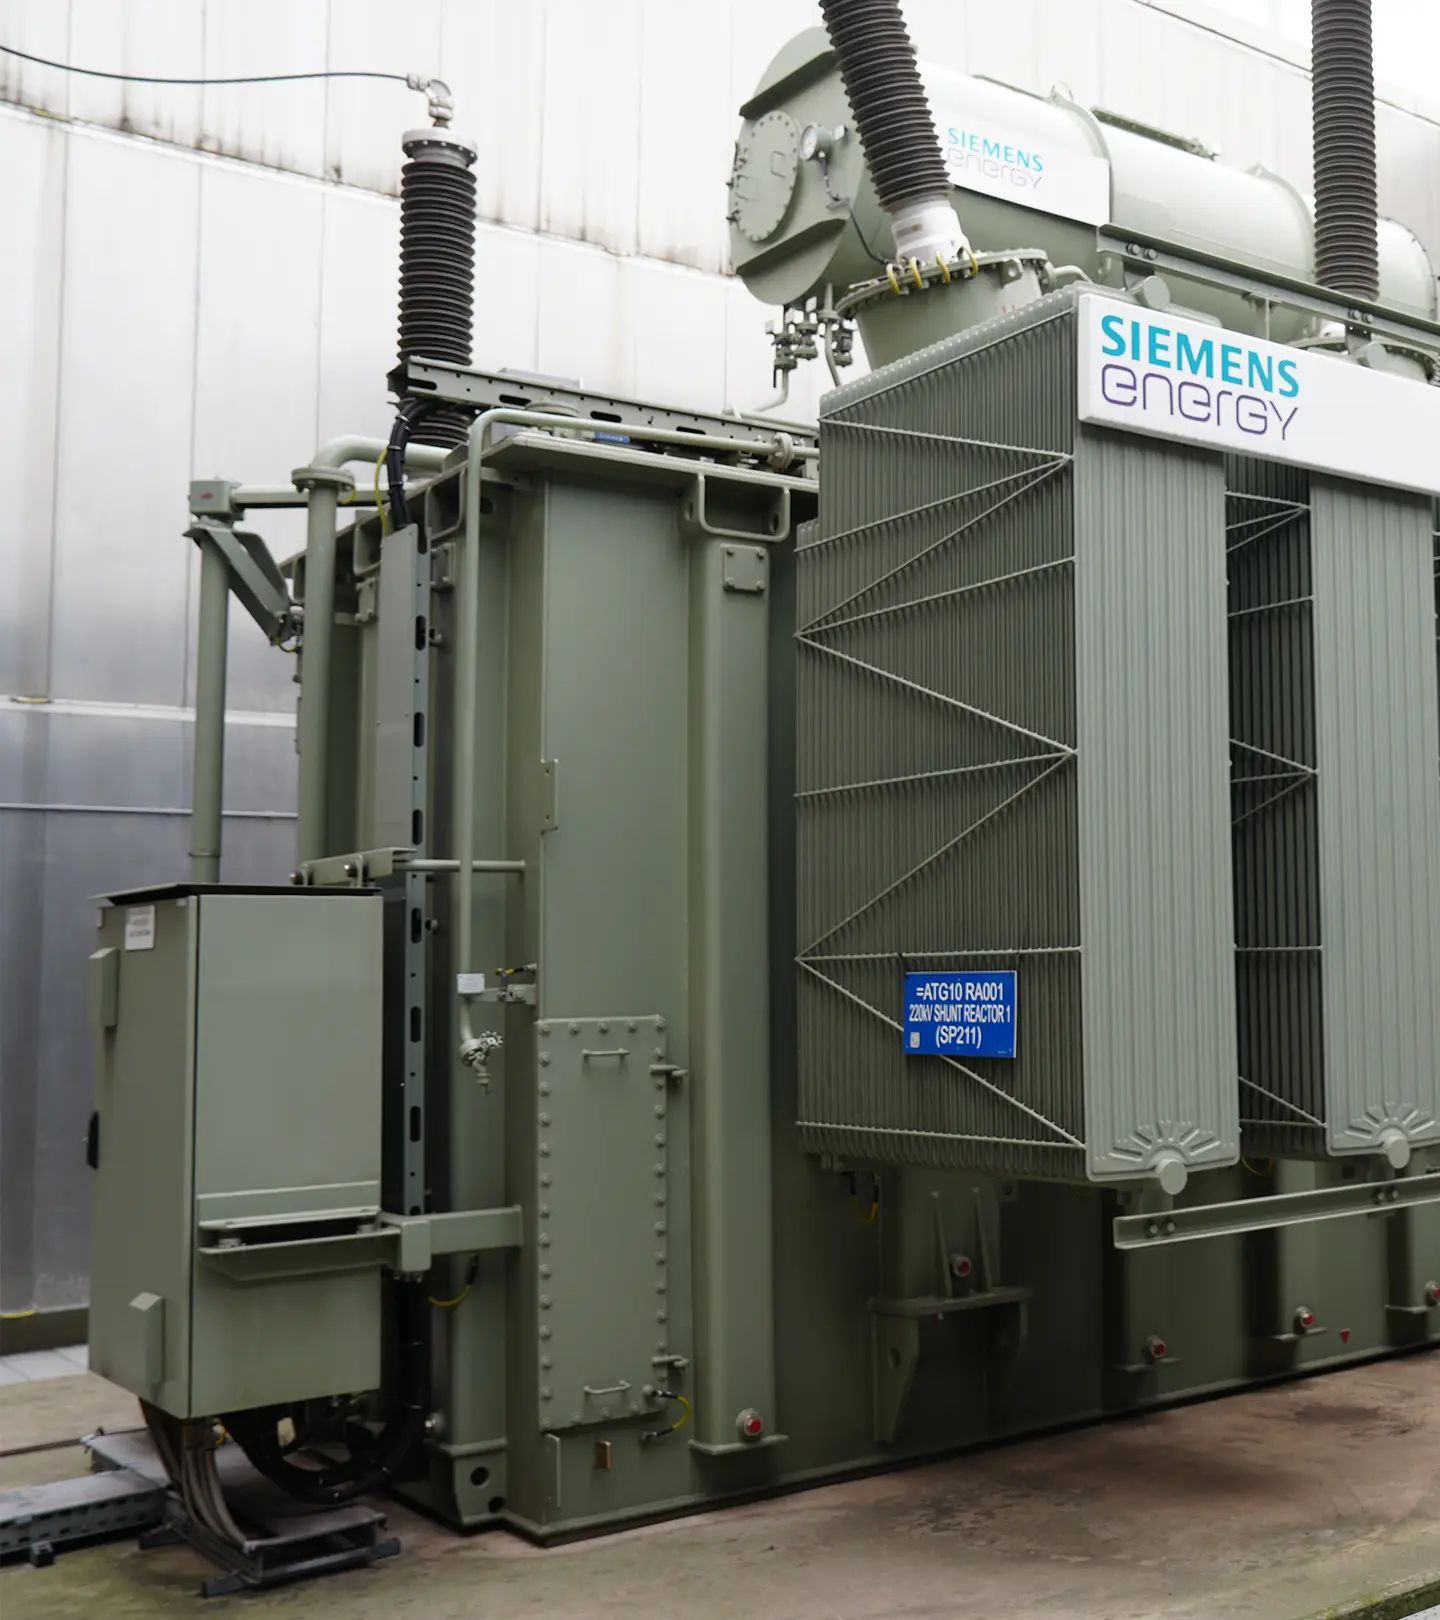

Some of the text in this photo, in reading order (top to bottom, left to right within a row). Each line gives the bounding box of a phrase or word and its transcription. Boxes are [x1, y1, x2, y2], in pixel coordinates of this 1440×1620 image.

[948, 127, 1044, 172] SIEMENS
[1101, 315, 1299, 398] SIEMENS
[916, 982, 1003, 1001] =ATG10 RA001
[909, 1004, 1011, 1023] 220kV SHUNT REACTOR 1
[935, 1025, 982, 1049] (SP211)
